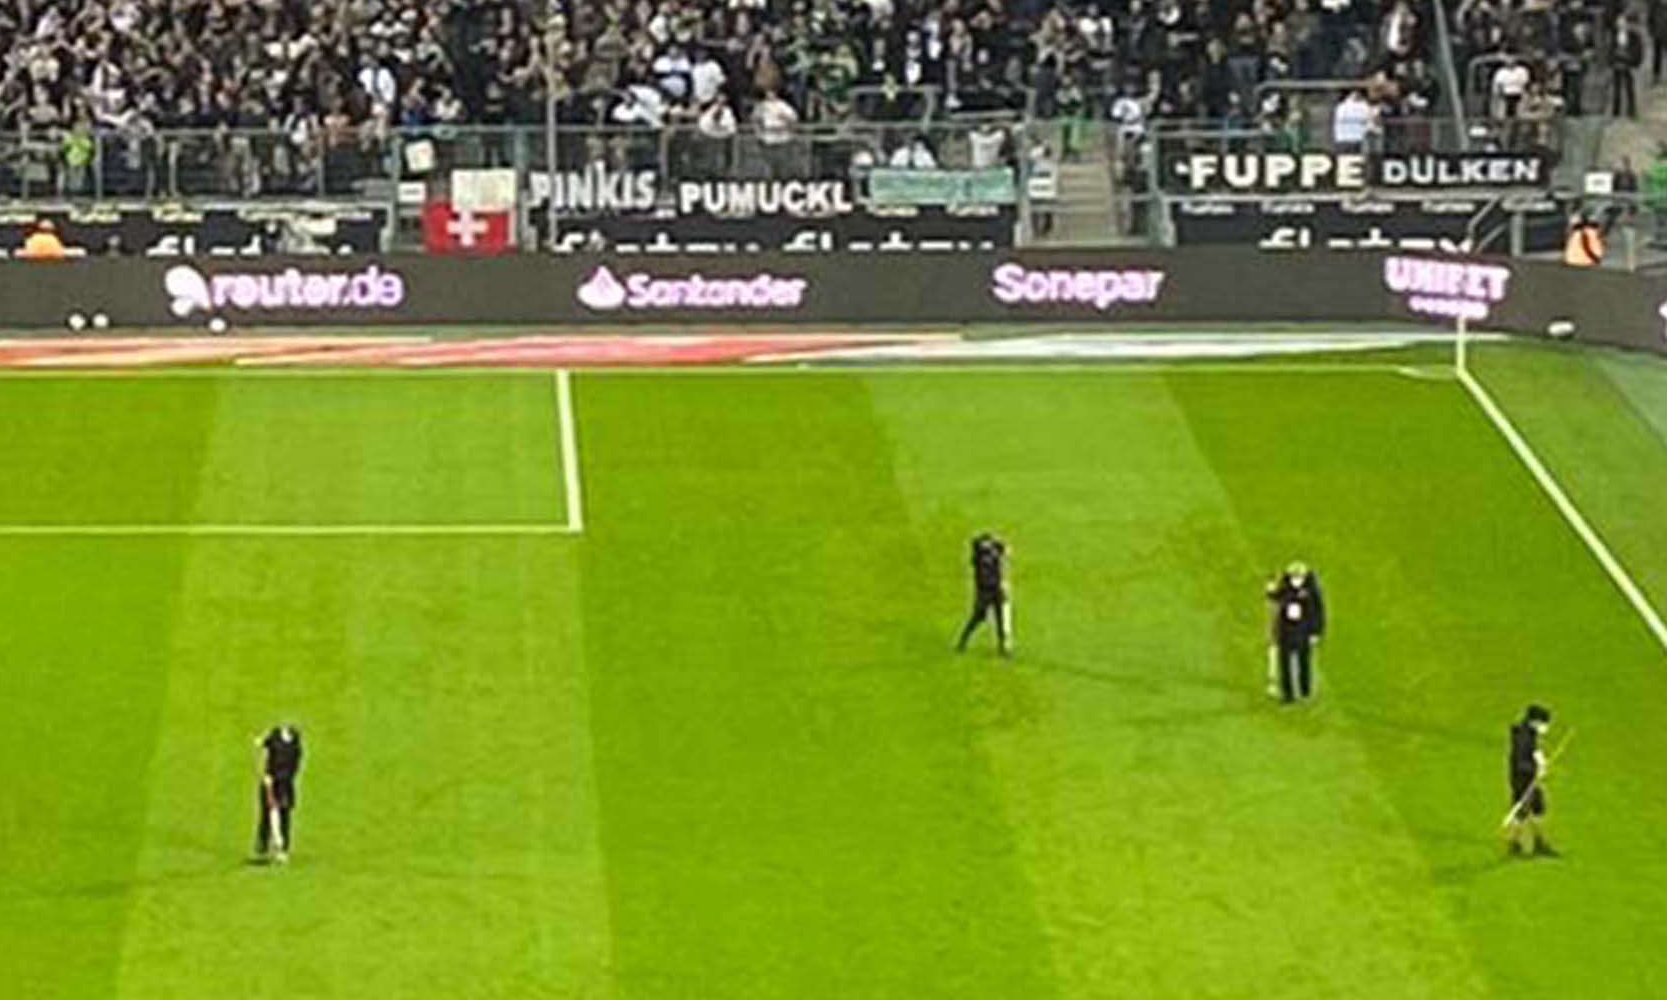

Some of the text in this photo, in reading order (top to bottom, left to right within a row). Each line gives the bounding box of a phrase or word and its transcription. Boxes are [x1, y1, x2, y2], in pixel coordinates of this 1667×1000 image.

[1191, 154, 1364, 188] FUPPE
[679, 181, 852, 213] PUMUCKL
[627, 273, 808, 308] Santander
[993, 263, 1165, 309] Sonepar
